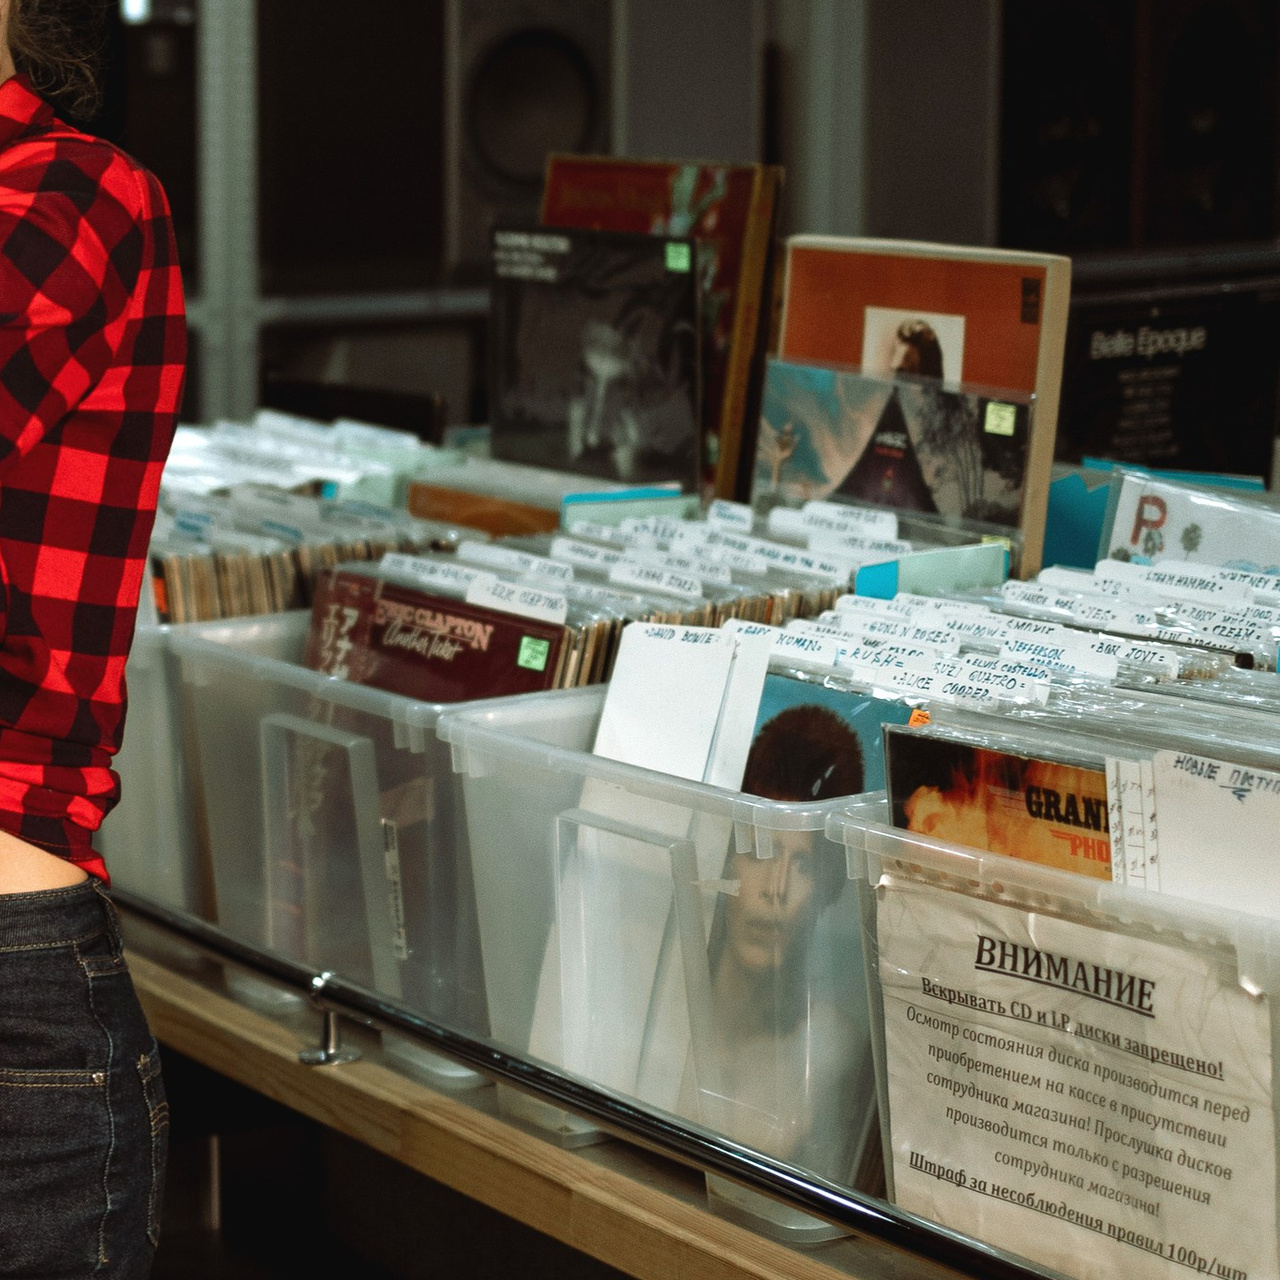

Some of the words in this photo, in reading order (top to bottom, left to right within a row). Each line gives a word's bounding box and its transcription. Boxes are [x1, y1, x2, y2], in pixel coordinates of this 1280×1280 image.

[1136, 325, 1207, 360] Epoque
[974, 934, 1156, 1013] ВНИМАНИЕ
[906, 1006, 959, 1039] Осмотр
[962, 1025, 1044, 1060] состояния
[1047, 1045, 1089, 1072] диска
[1093, 1059, 1199, 1108] производится
[1203, 1097, 1251, 1123] перед
[921, 977, 1005, 1016] Вскрывать
[1010, 1001, 1032, 1022] CD
[1036, 1010, 1046, 1024] и
[1050, 1009, 1071, 1031] LP
[1074, 1019, 1120, 1047] диски
[1124, 1034, 1224, 1079] запрещено!
[926, 1072, 1008, 1113] сотрудника
[1012, 1097, 1090, 1132] магазина!
[1094, 1120, 1172, 1163] Прослушка
[1177, 1149, 1232, 1181] дисков
[927, 1043, 1041, 1088] приобретением
[1045, 1077, 1064, 1095] на
[1068, 1082, 1106, 1107] кассе
[1109, 1096, 1117, 1109] в
[1121, 1102, 1227, 1148] присутствии
[909, 1151, 966, 1187] Штраф
[970, 1176, 987, 1192] за
[991, 1182, 1103, 1231] несоблюдения
[1107, 1220, 1163, 1255] правил
[946, 1105, 1048, 1148] производится
[1052, 1139, 1108, 1172] только
[1122, 1161, 1211, 1205] разрешения
[994, 1150, 1084, 1191] сотрудника
[1088, 1180, 1160, 1217] магазина!
